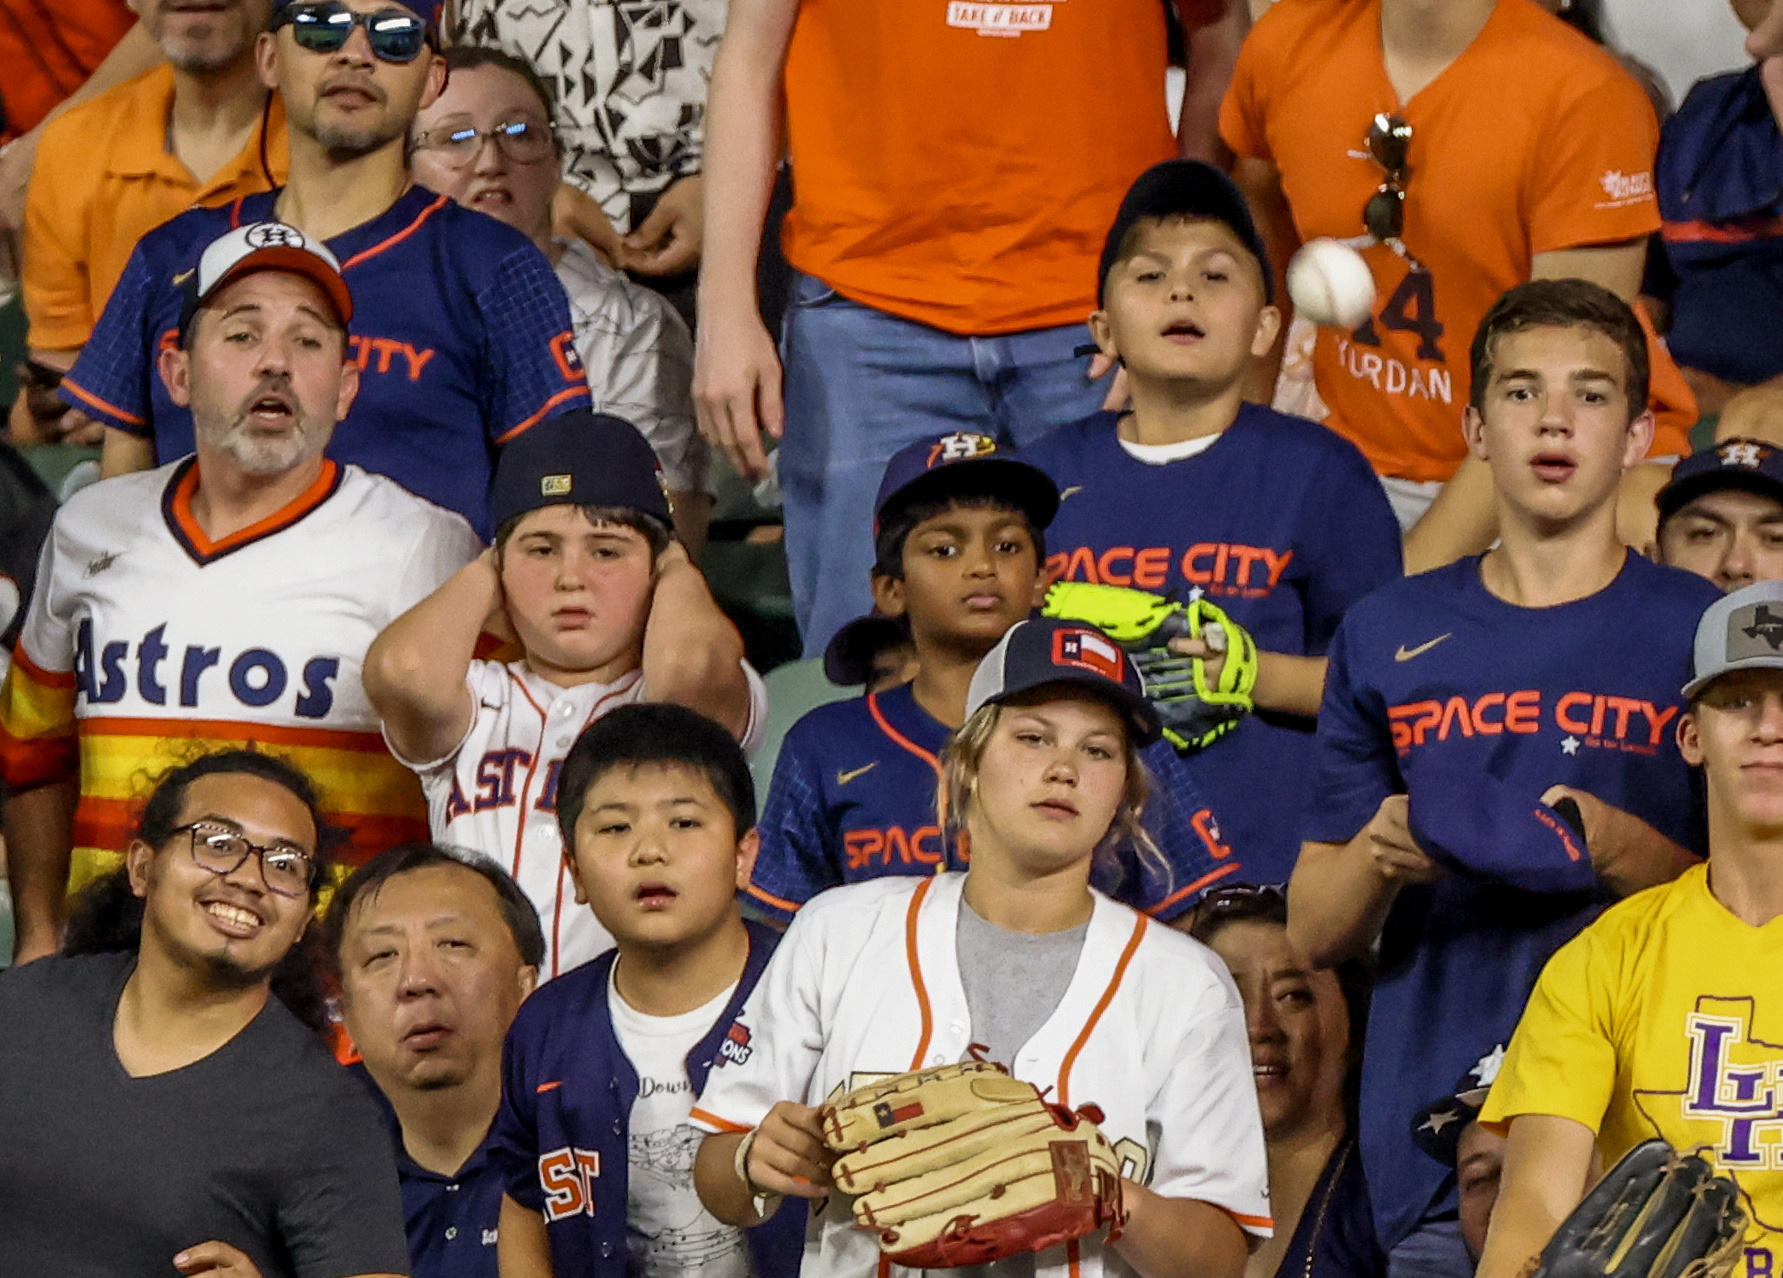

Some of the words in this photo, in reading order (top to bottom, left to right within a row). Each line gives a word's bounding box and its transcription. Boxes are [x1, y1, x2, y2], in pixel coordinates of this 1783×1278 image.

[346, 335, 435, 381] ITY
[1181, 542, 1293, 587] CITY
[1554, 690, 1680, 747] CITY
[537, 1147, 601, 1225] ST
